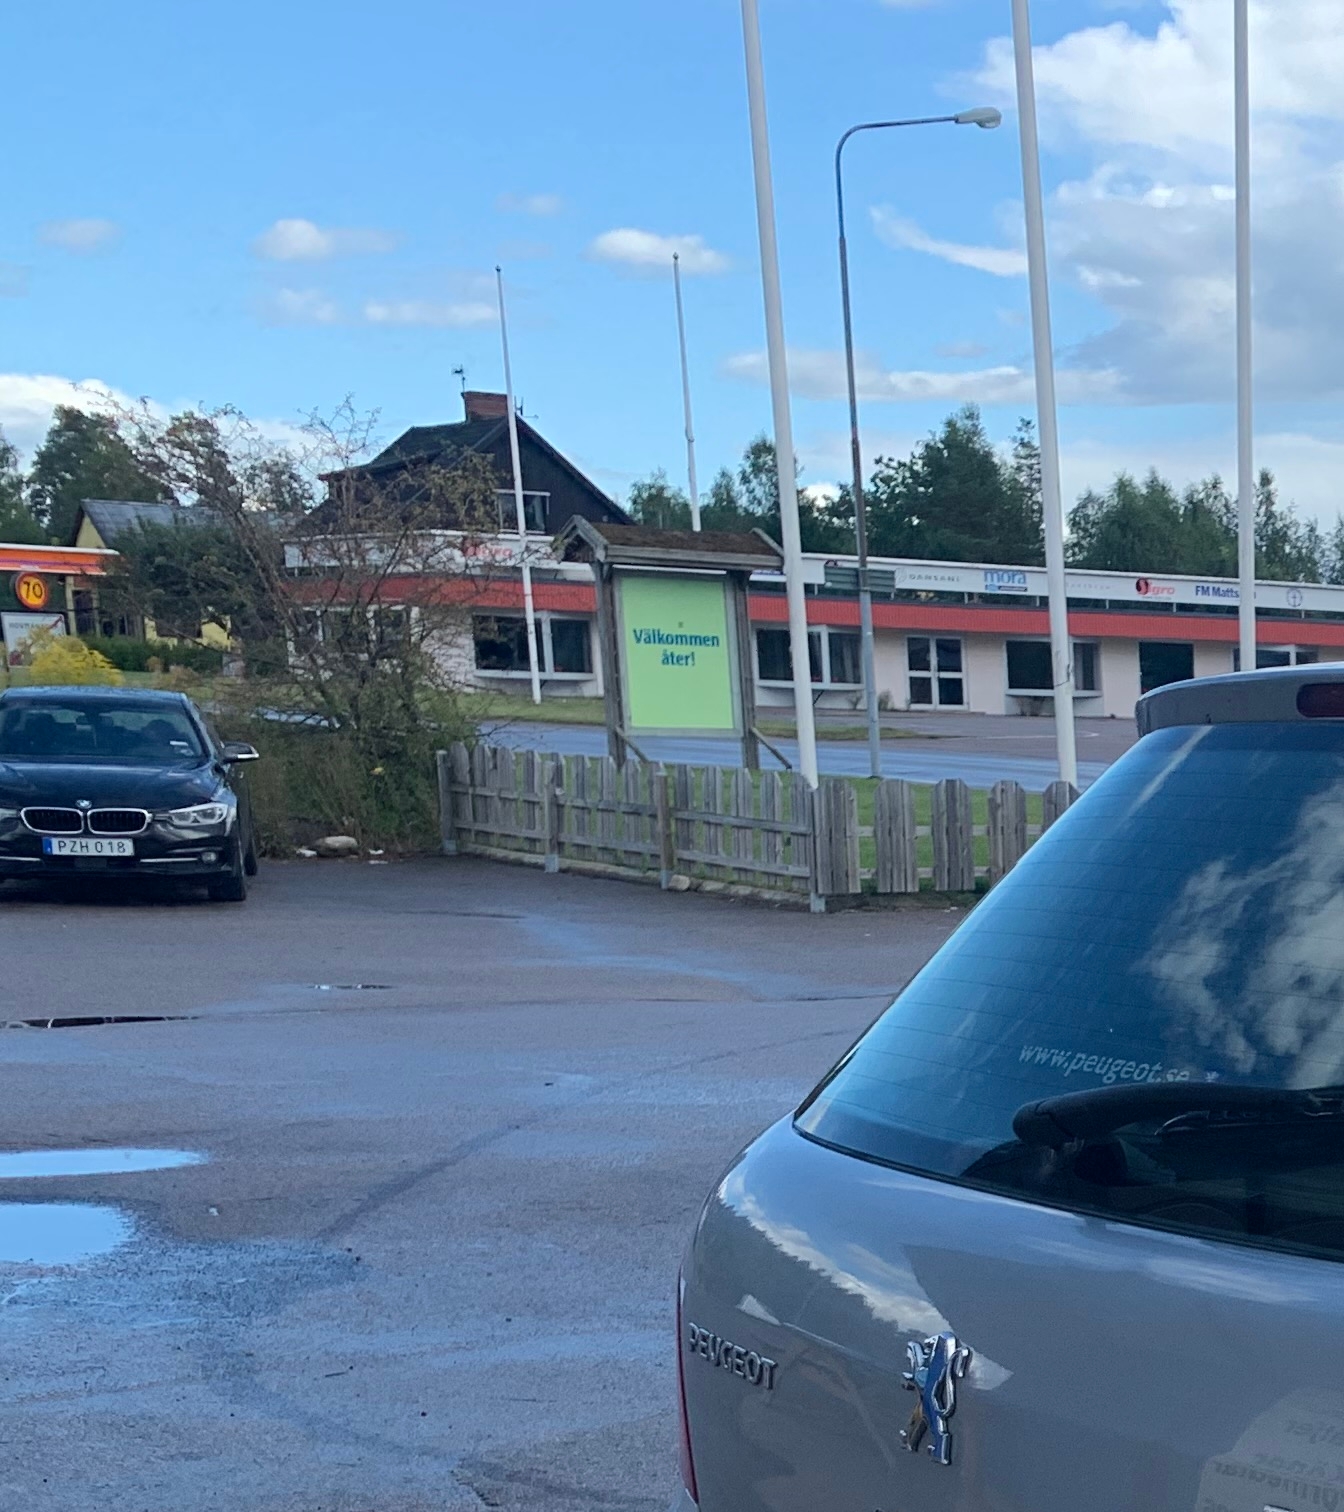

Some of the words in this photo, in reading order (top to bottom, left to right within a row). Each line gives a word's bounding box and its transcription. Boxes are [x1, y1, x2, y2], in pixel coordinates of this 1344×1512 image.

[984, 569, 1027, 584] mora
[23, 580, 43, 600] 70
[1196, 585, 1211, 597] FM
[632, 628, 719, 647] Välkommen
[661, 649, 695, 666] åter!
[58, 840, 89, 853] PZH
[94, 841, 126, 853] 018
[1018, 1046, 1190, 1084] www.peugeot.se
[688, 1322, 778, 1390] PEUGEOT
